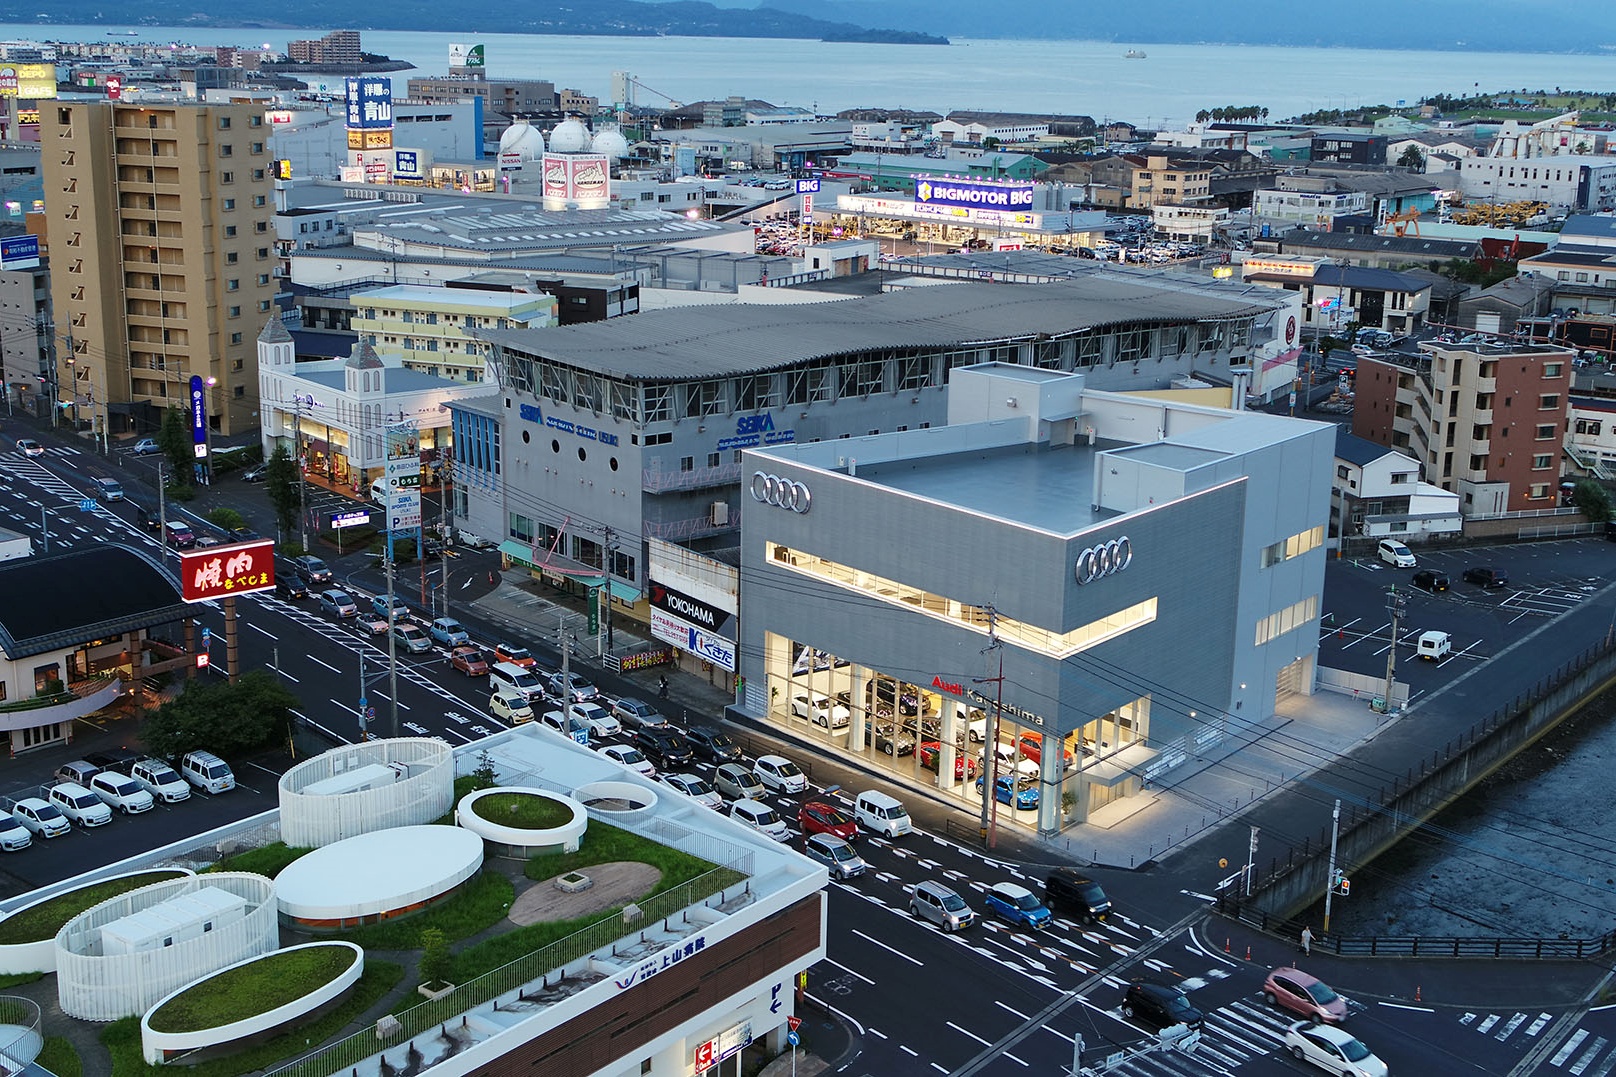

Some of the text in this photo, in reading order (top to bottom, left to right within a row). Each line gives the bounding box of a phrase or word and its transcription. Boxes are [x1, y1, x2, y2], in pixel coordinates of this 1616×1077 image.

[18, 70, 46, 78] DEPO
[364, 83, 390, 96] 洋服の
[364, 101, 391, 121] 青山
[399, 160, 416, 171] 青山
[799, 180, 819, 192] BIG
[934, 187, 1032, 205] BIGMOTOR BIG
[736, 410, 776, 435] SEIKA
[392, 518, 400, 528] P
[194, 552, 252, 591] 焼肉
[224, 572, 268, 590] なべしま
[666, 592, 714, 626] YOKOHAMA
[704, 643, 733, 664] くきた
[932, 676, 962, 696] Audi
[660, 936, 706, 970] 上山病院
[771, 982, 782, 1000] P
